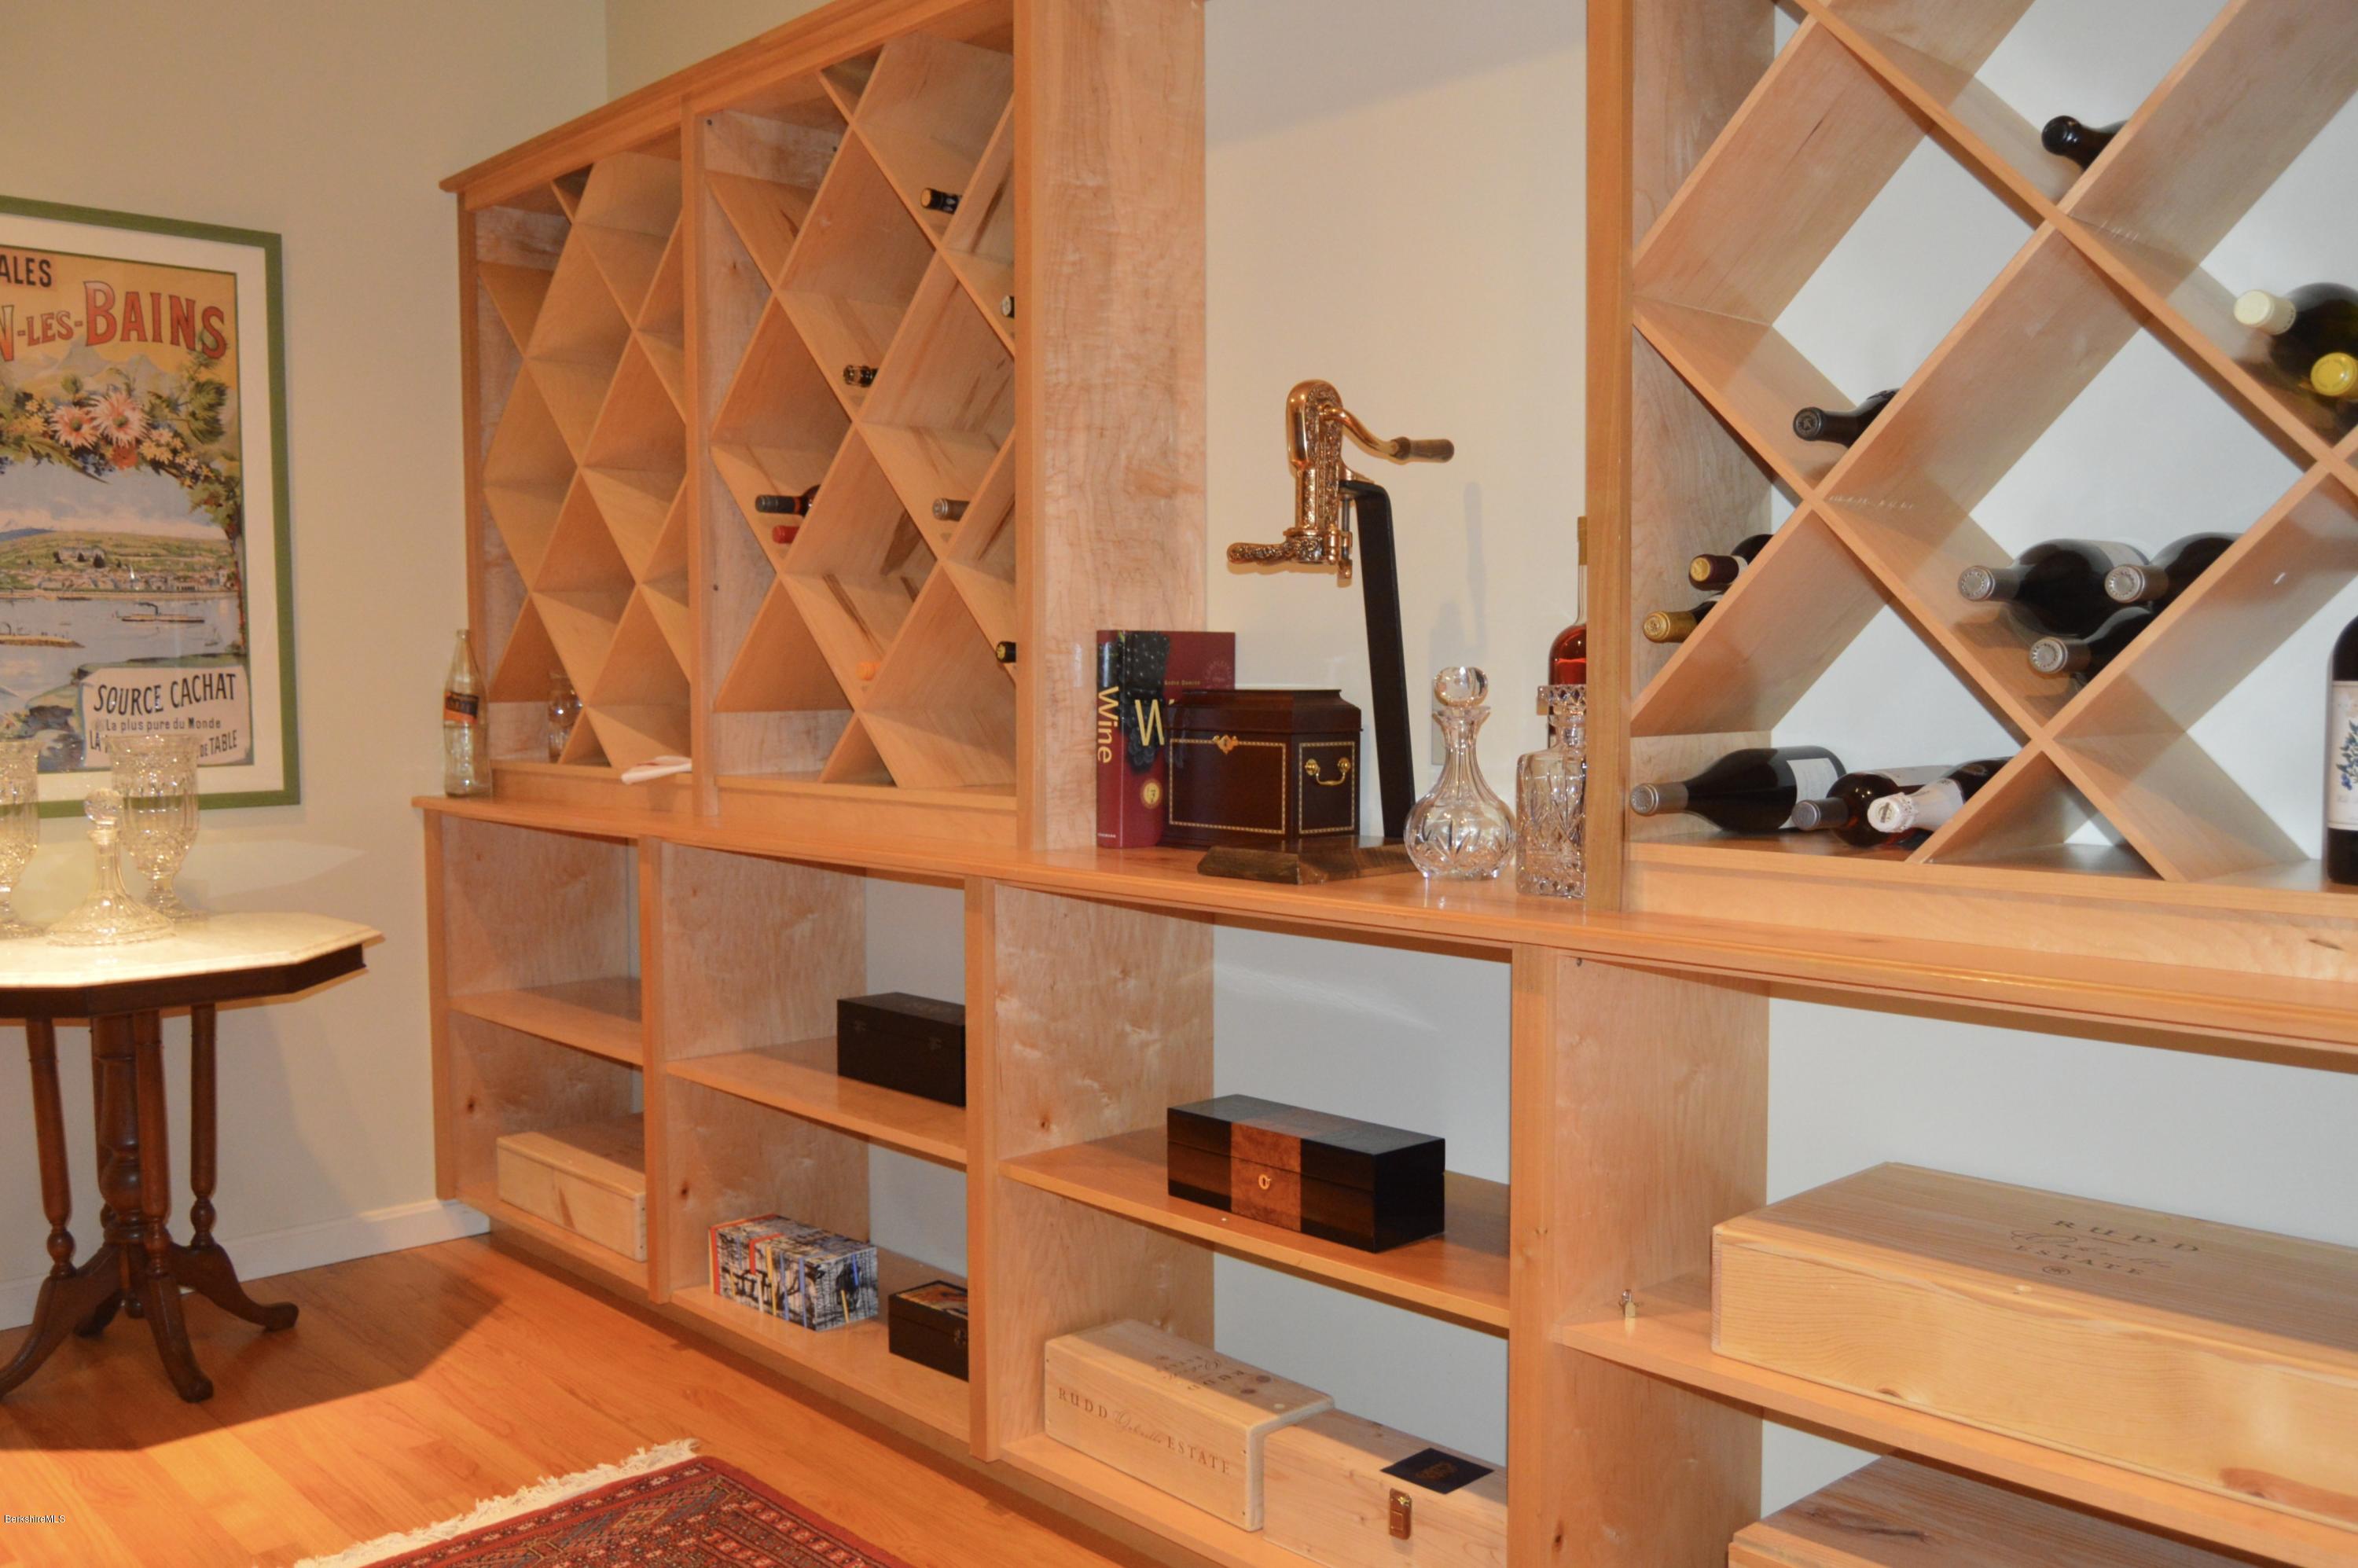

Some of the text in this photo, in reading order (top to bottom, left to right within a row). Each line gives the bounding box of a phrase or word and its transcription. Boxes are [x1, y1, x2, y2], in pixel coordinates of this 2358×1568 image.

[94, 673, 236, 716] SOURCE CACHAT
[106, 717, 222, 733] La plus pure du Monde
[1098, 686, 1119, 764] Wine
[209, 729, 237, 755] TABLE
[2051, 1220, 2199, 1251] RUDD
[2016, 1245, 2144, 1275] ESTATE
[1058, 1387, 1107, 1419] RUDD
[1167, 1435, 1230, 1474] ESTATE
